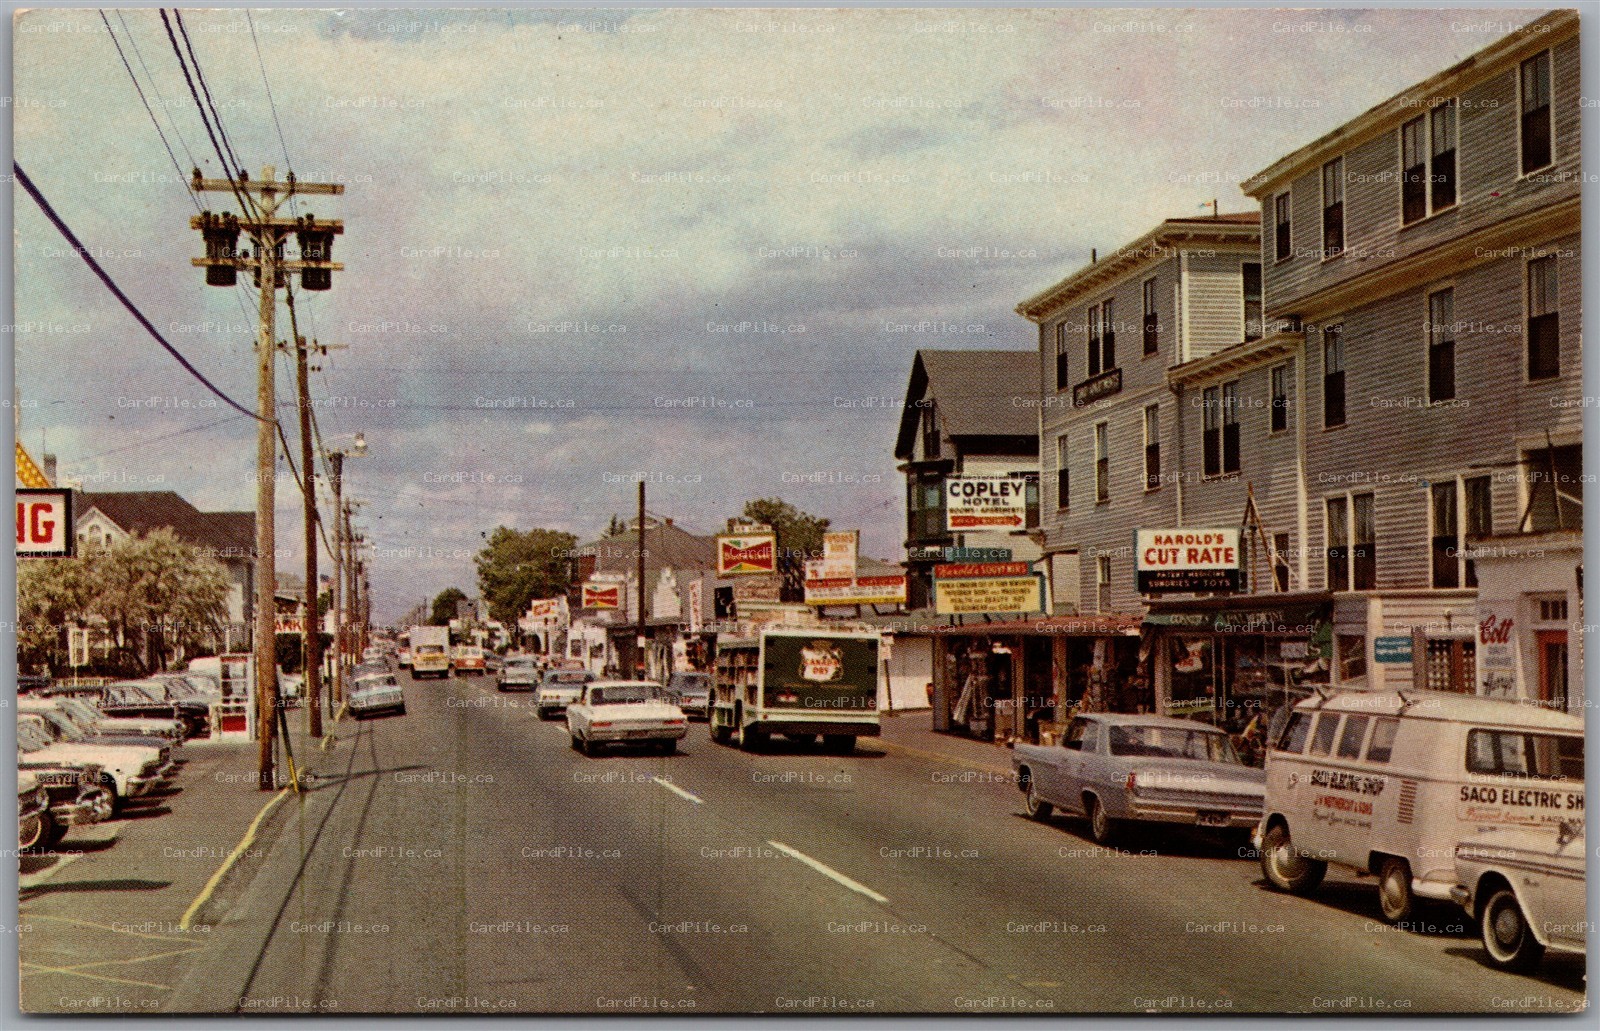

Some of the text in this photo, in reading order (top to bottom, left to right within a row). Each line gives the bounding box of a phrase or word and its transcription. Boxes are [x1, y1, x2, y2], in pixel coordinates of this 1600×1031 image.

[950, 481, 1023, 497] COPLEY
[963, 498, 1009, 506] HOTEL
[1154, 534, 1224, 545] HAROLD'S
[1144, 547, 1234, 565] CUT RATE
[1148, 579, 1190, 588] SUNDRIES
[1460, 786, 1497, 804] SACO
[1502, 789, 1561, 809] ELECTRIC
